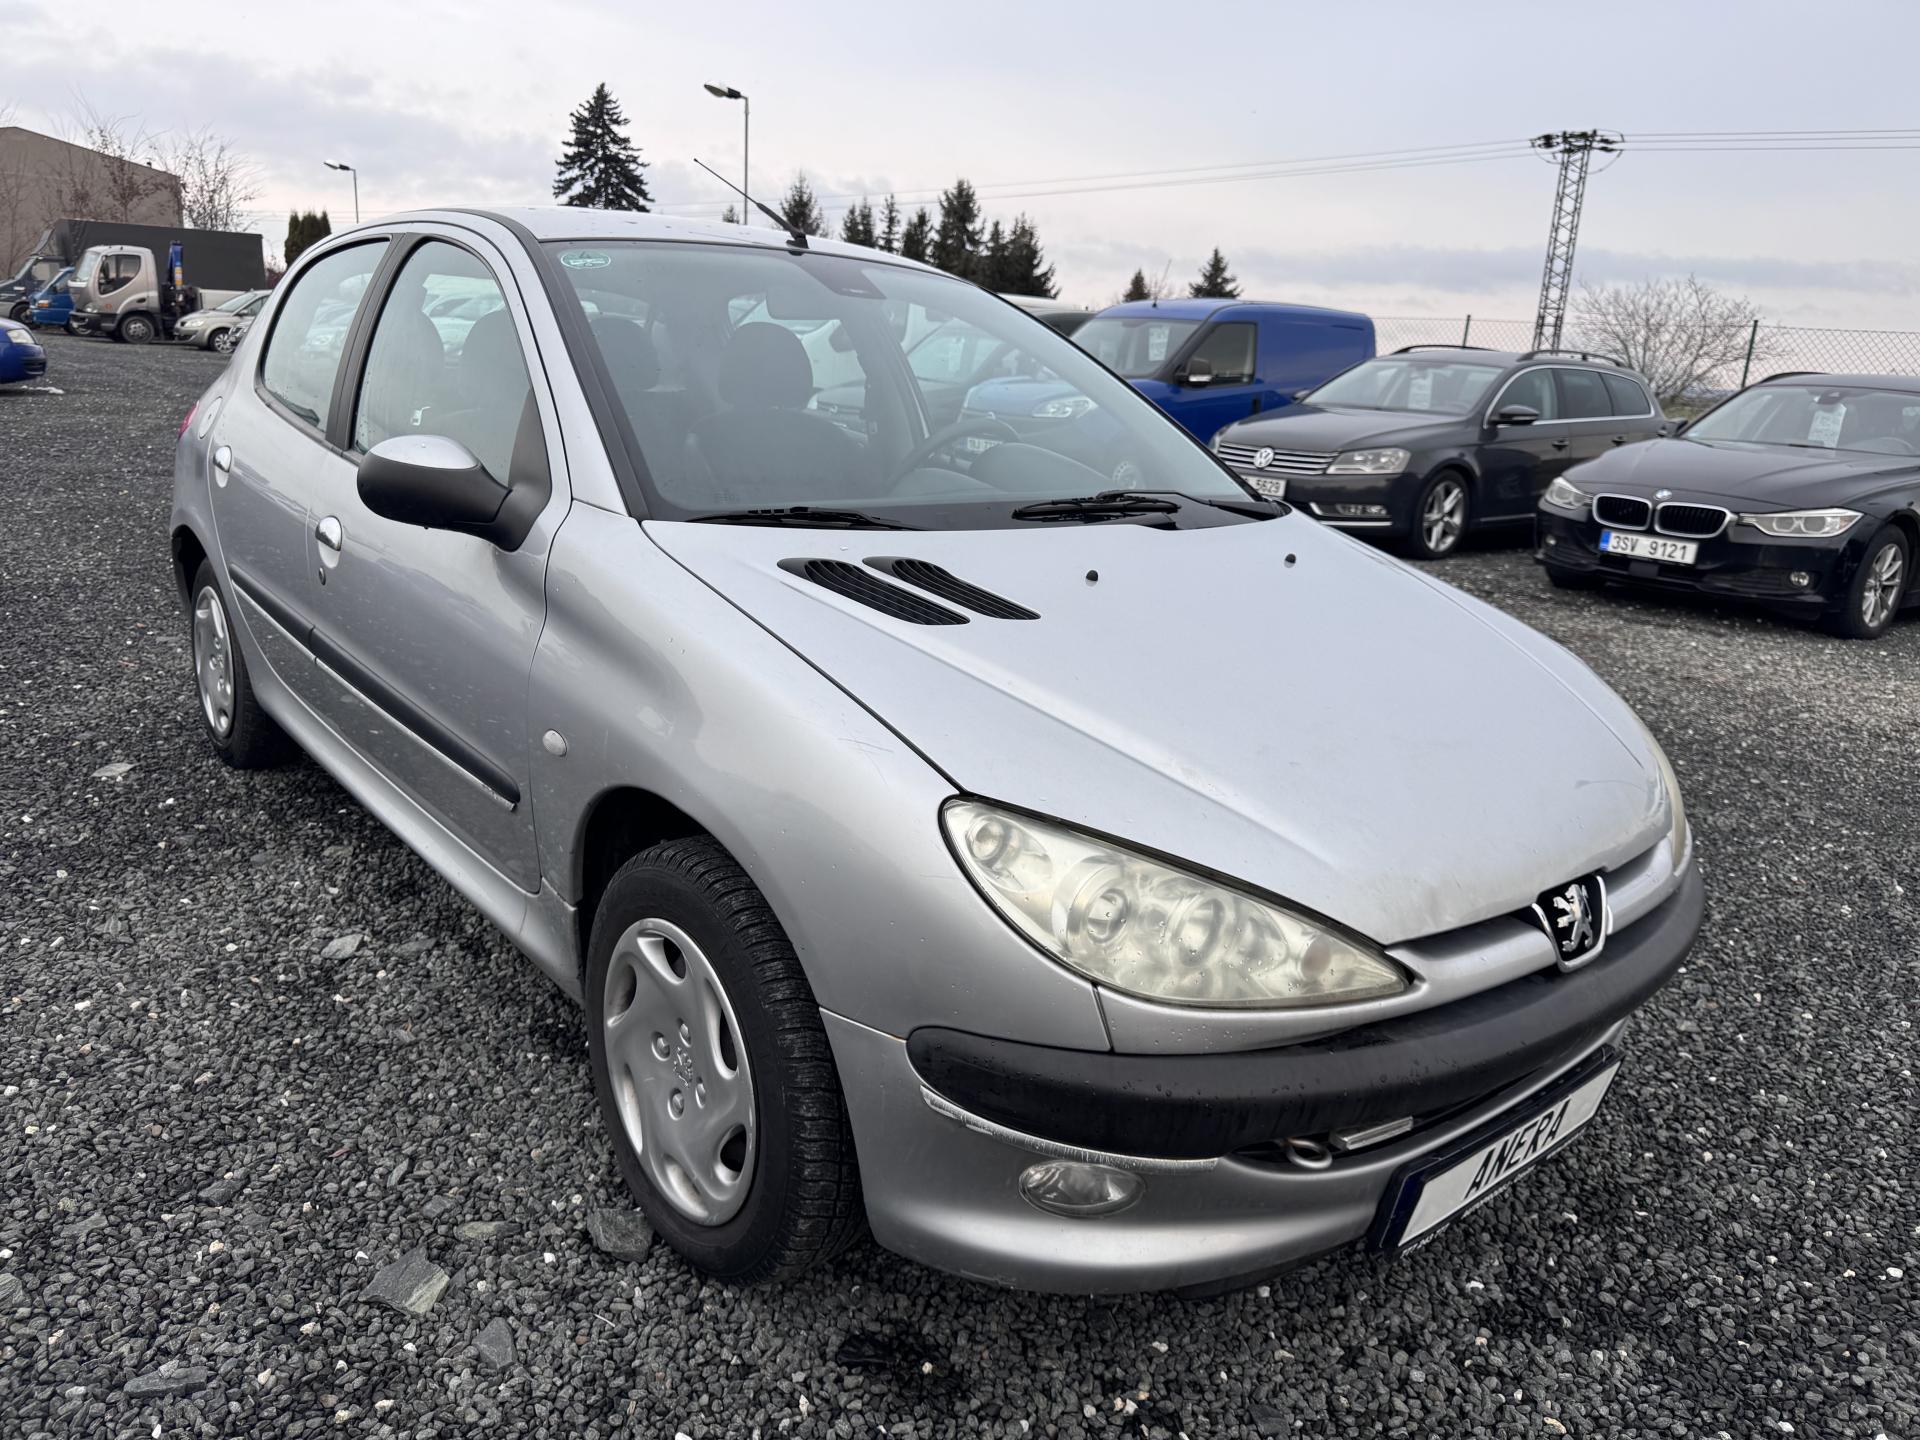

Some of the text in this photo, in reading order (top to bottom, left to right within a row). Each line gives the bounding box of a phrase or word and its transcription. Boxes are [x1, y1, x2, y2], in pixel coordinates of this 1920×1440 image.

[1612, 536, 1687, 560] 3SV 9121
[1464, 1099, 1570, 1200] ANERA
